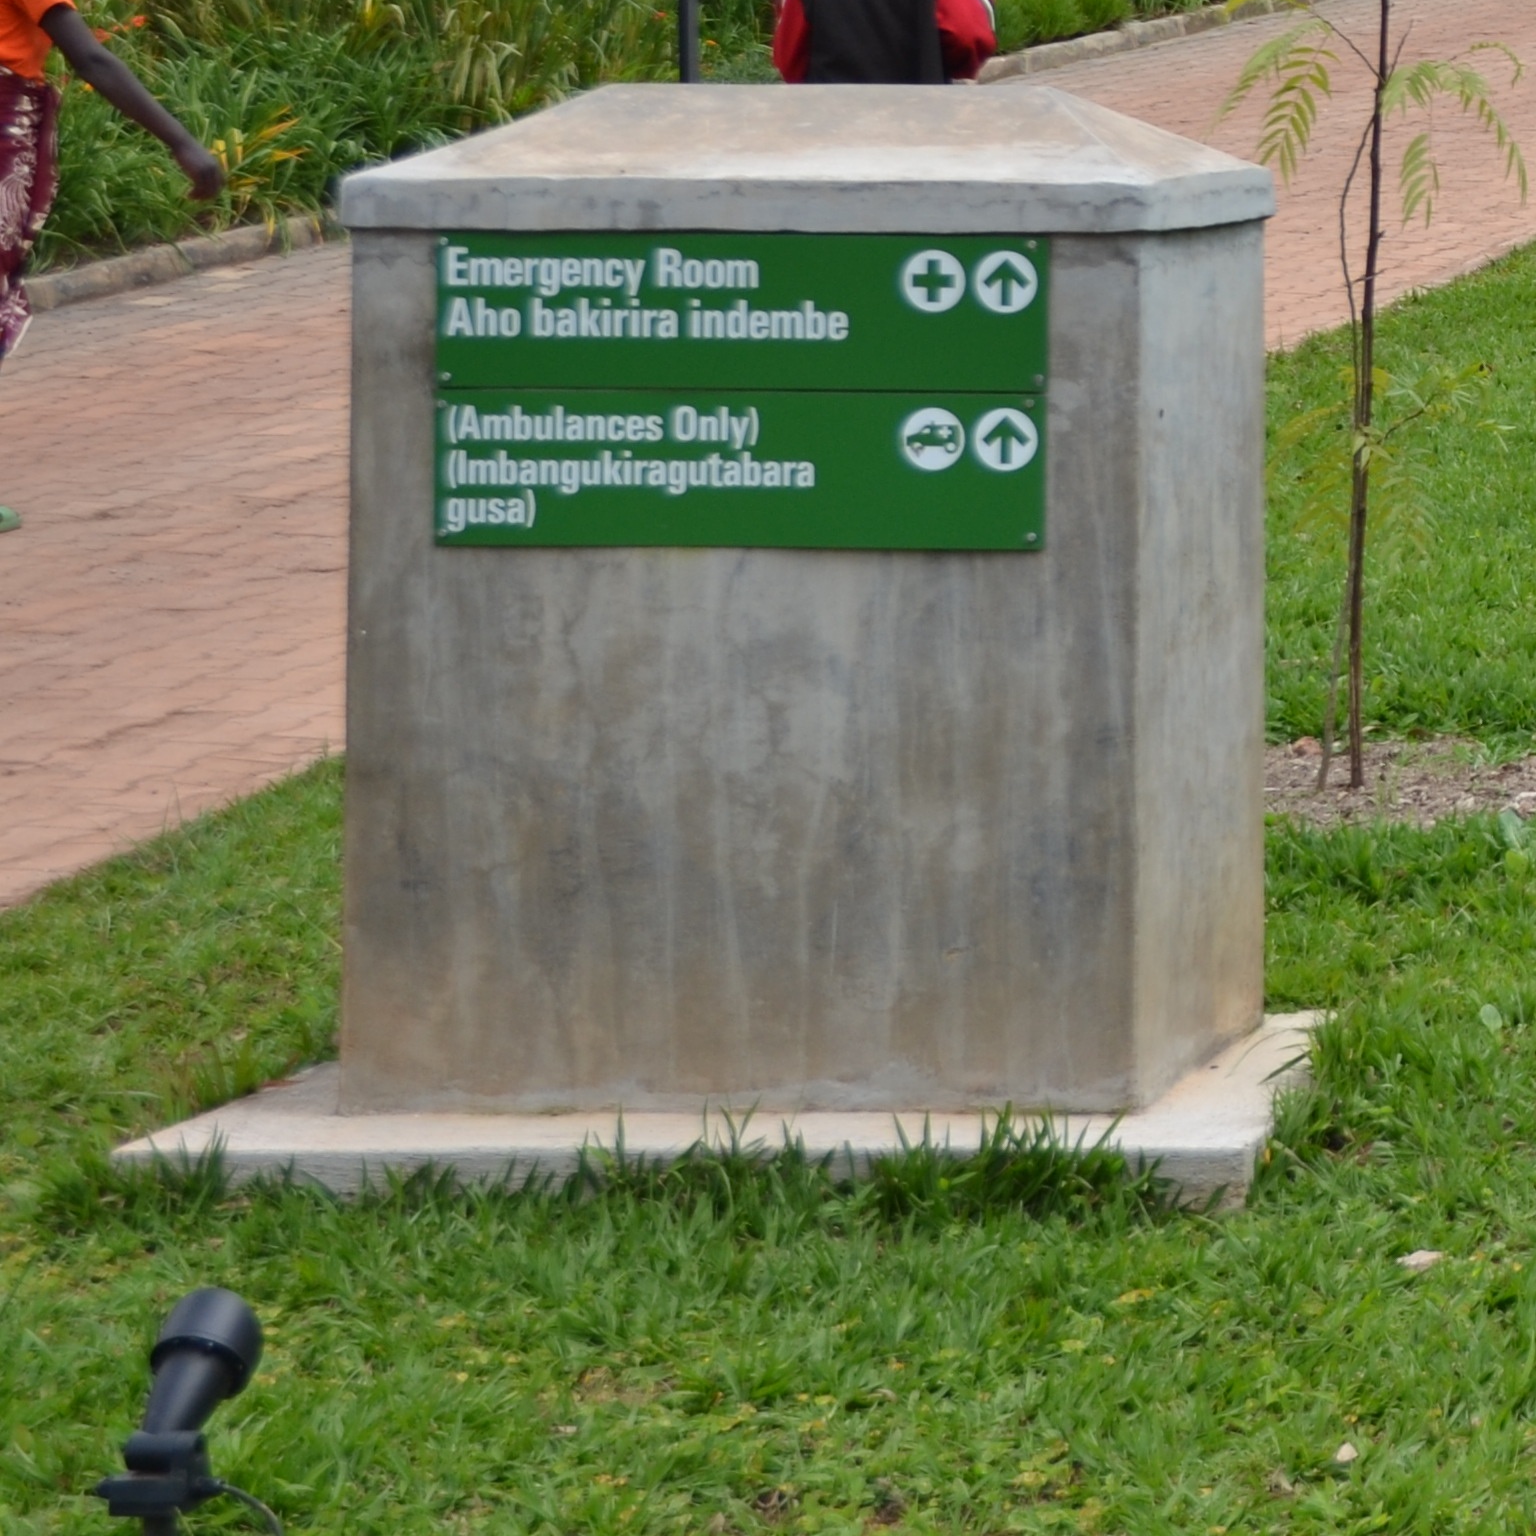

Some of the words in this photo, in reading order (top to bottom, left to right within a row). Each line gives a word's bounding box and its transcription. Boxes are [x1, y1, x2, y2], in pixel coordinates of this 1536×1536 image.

[446, 247, 645, 296] Emergency
[656, 248, 758, 288] Room
[446, 298, 520, 338] Aho
[531, 298, 678, 339] bakirira
[688, 300, 849, 340] indembe
[447, 405, 663, 443] (Ambulances
[674, 406, 759, 448] Only)
[447, 450, 815, 495] (Imbangukiragutabara
[446, 488, 537, 533] gusa)
